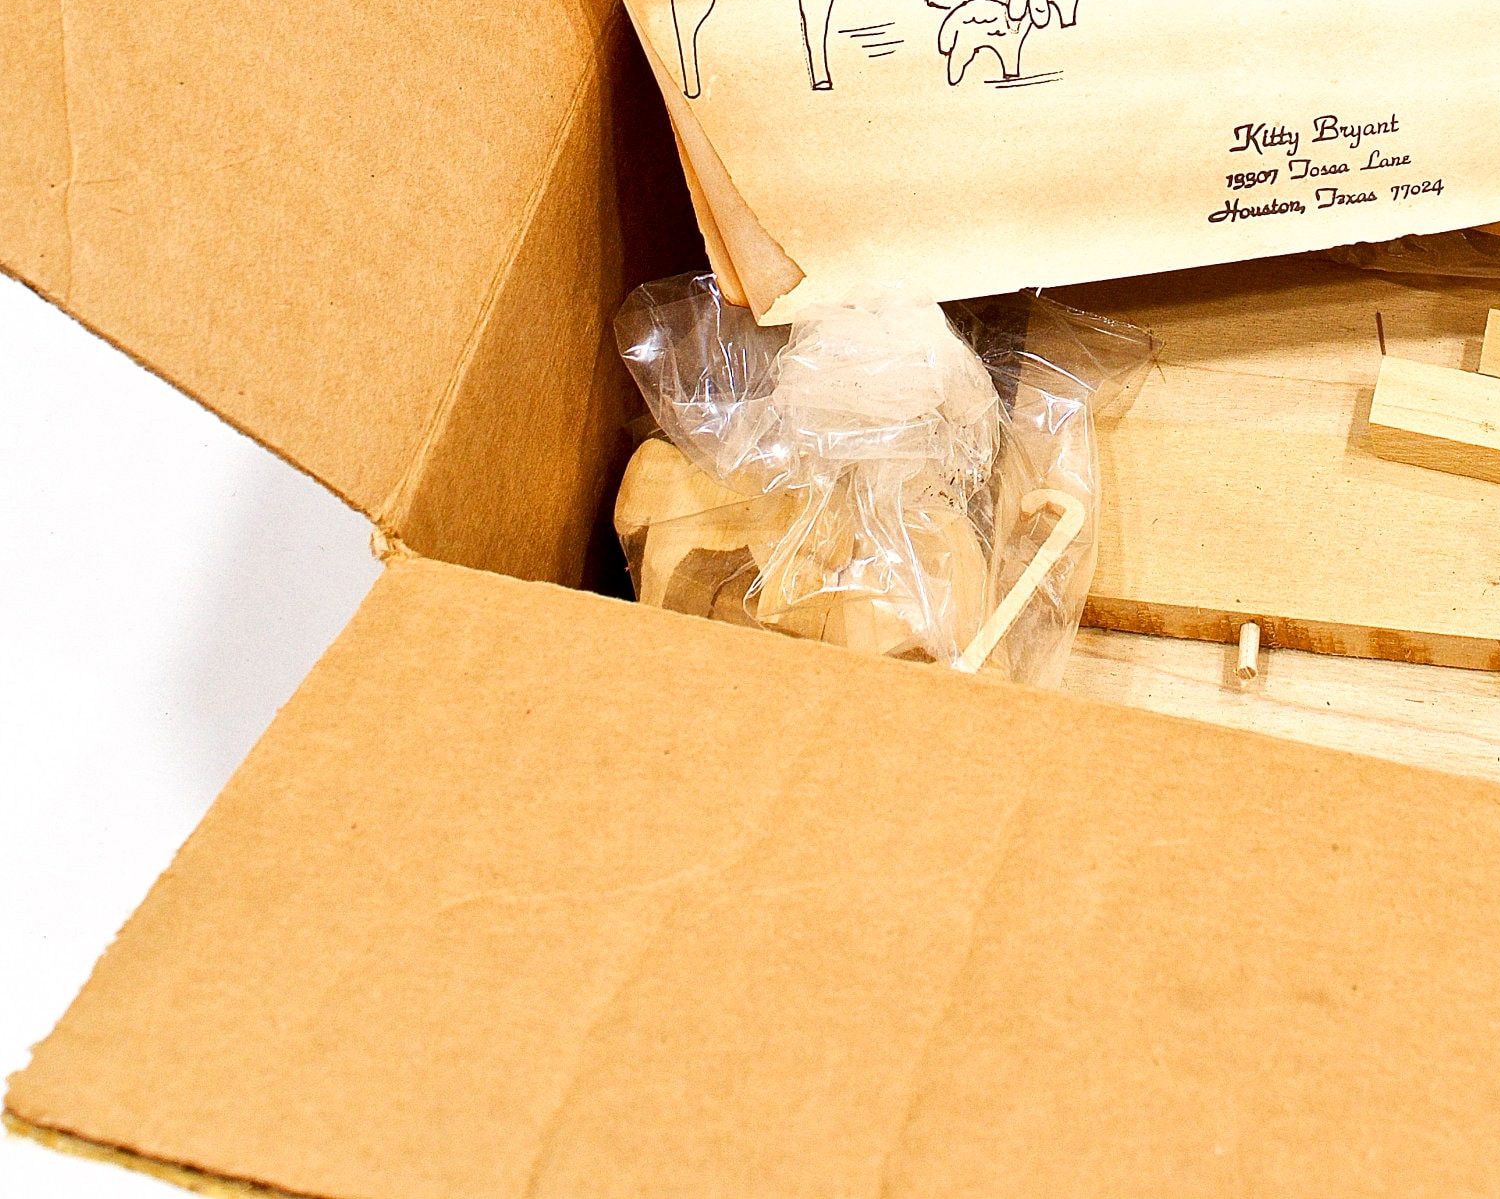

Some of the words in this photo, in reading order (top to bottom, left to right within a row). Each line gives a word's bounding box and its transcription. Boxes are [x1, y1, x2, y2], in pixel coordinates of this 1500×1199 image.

[1229, 123, 1299, 156] Kitty
[1312, 113, 1399, 148] Bryant
[1360, 150, 1411, 171] Lane
[1208, 198, 1306, 223] Houston,
[1316, 188, 1377, 209] Texas
[1391, 179, 1444, 201] 77024
